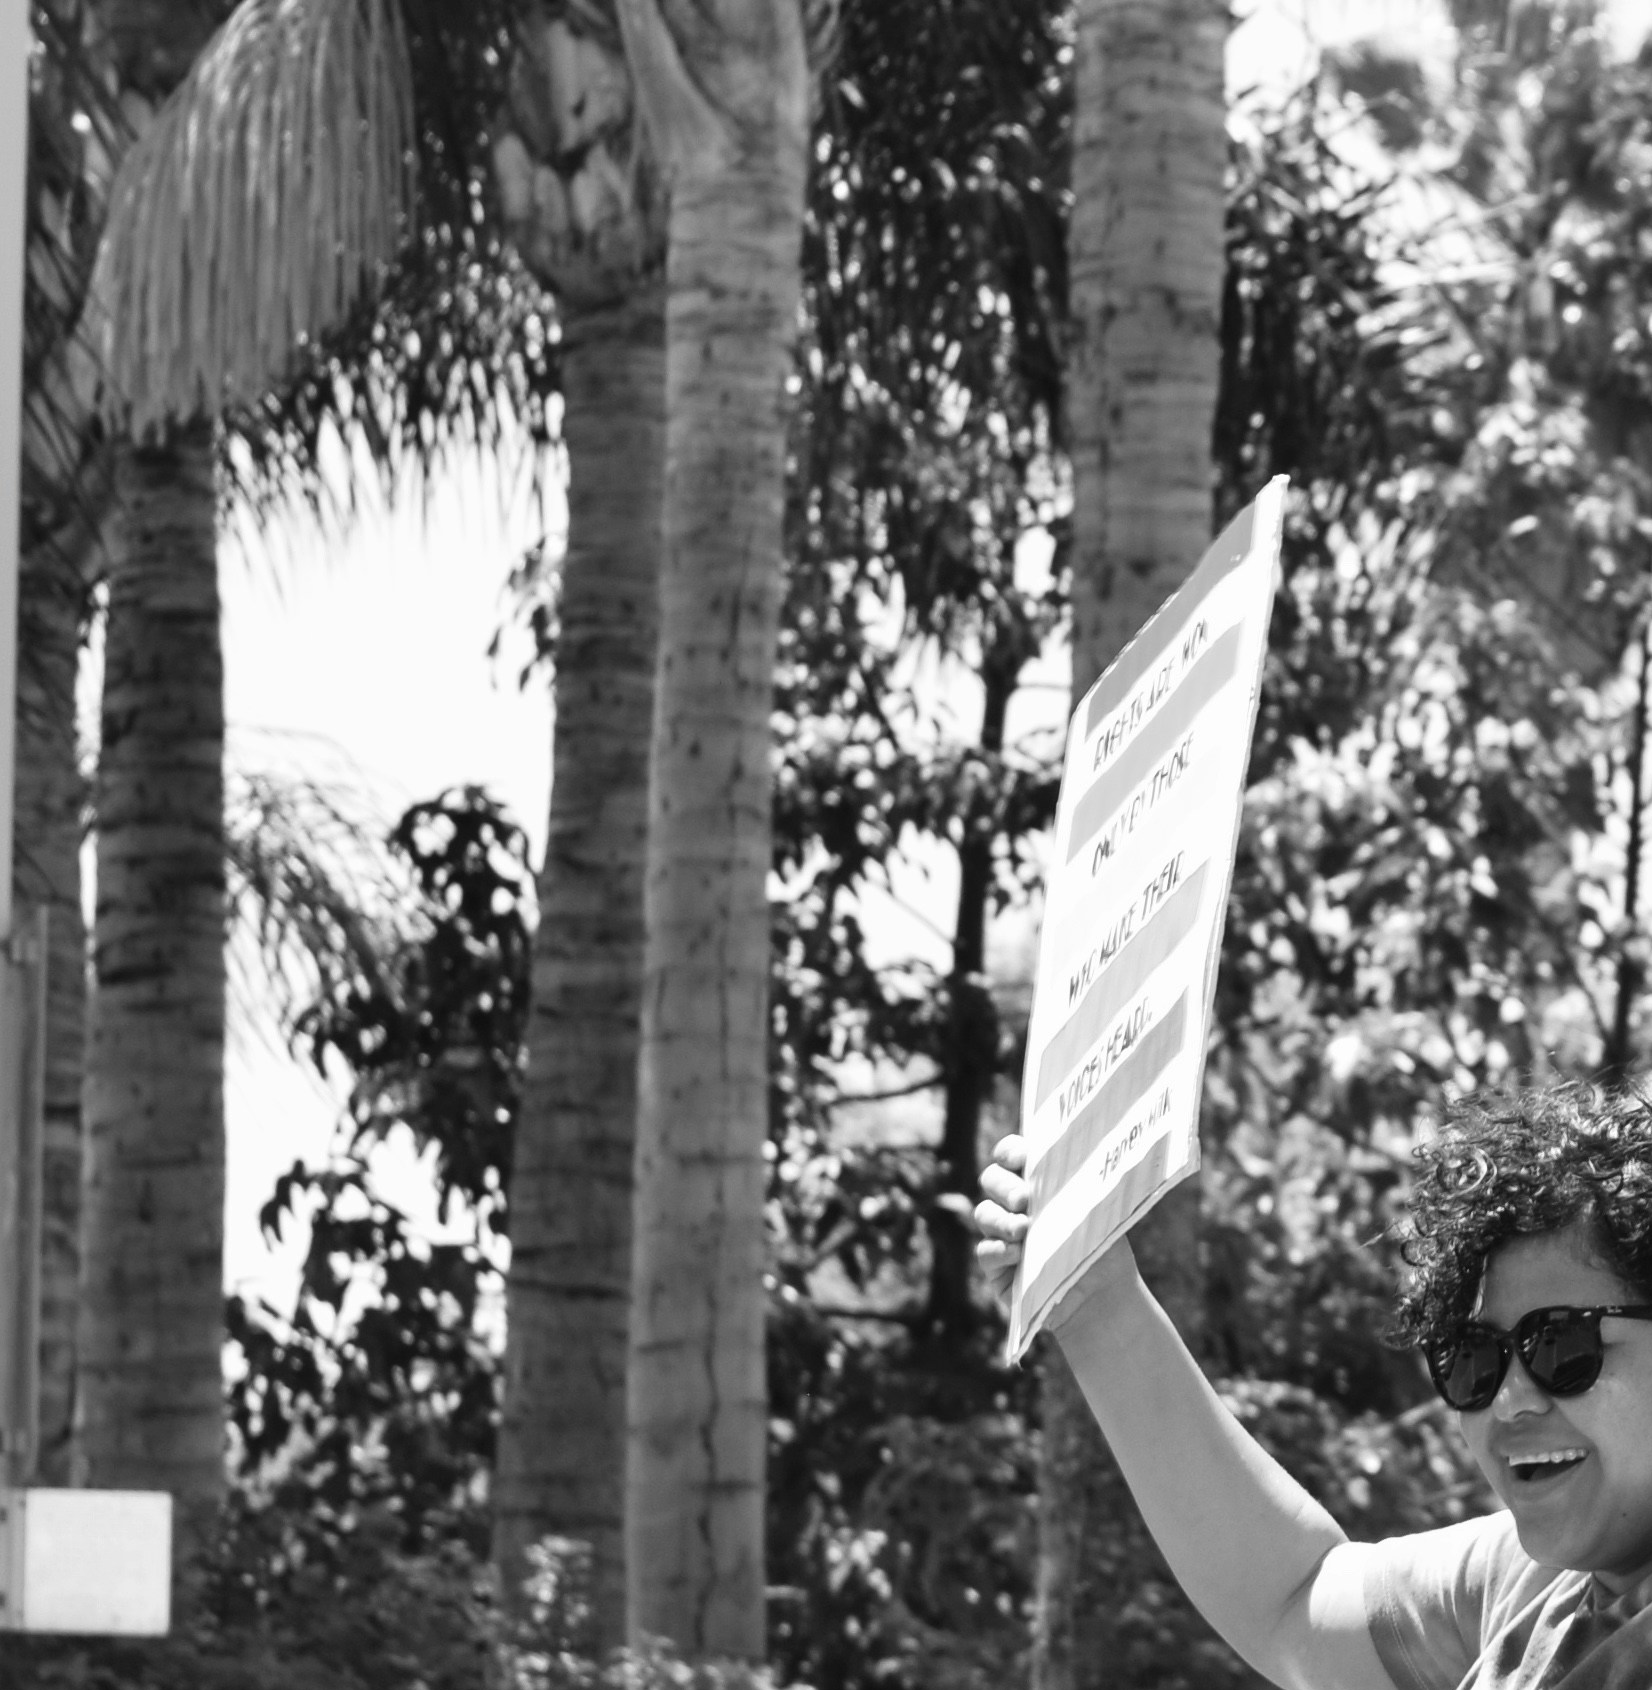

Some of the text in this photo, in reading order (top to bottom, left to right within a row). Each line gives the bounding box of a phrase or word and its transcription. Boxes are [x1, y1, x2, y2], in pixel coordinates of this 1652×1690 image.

[1093, 690, 1145, 773] RIGHTS
[1145, 656, 1176, 713] ARE
[1149, 729, 1195, 809] THOSE
[1099, 900, 1138, 966] MAKE
[1141, 849, 1185, 922] THEIR
[1058, 1045, 1105, 1124] VOICES
